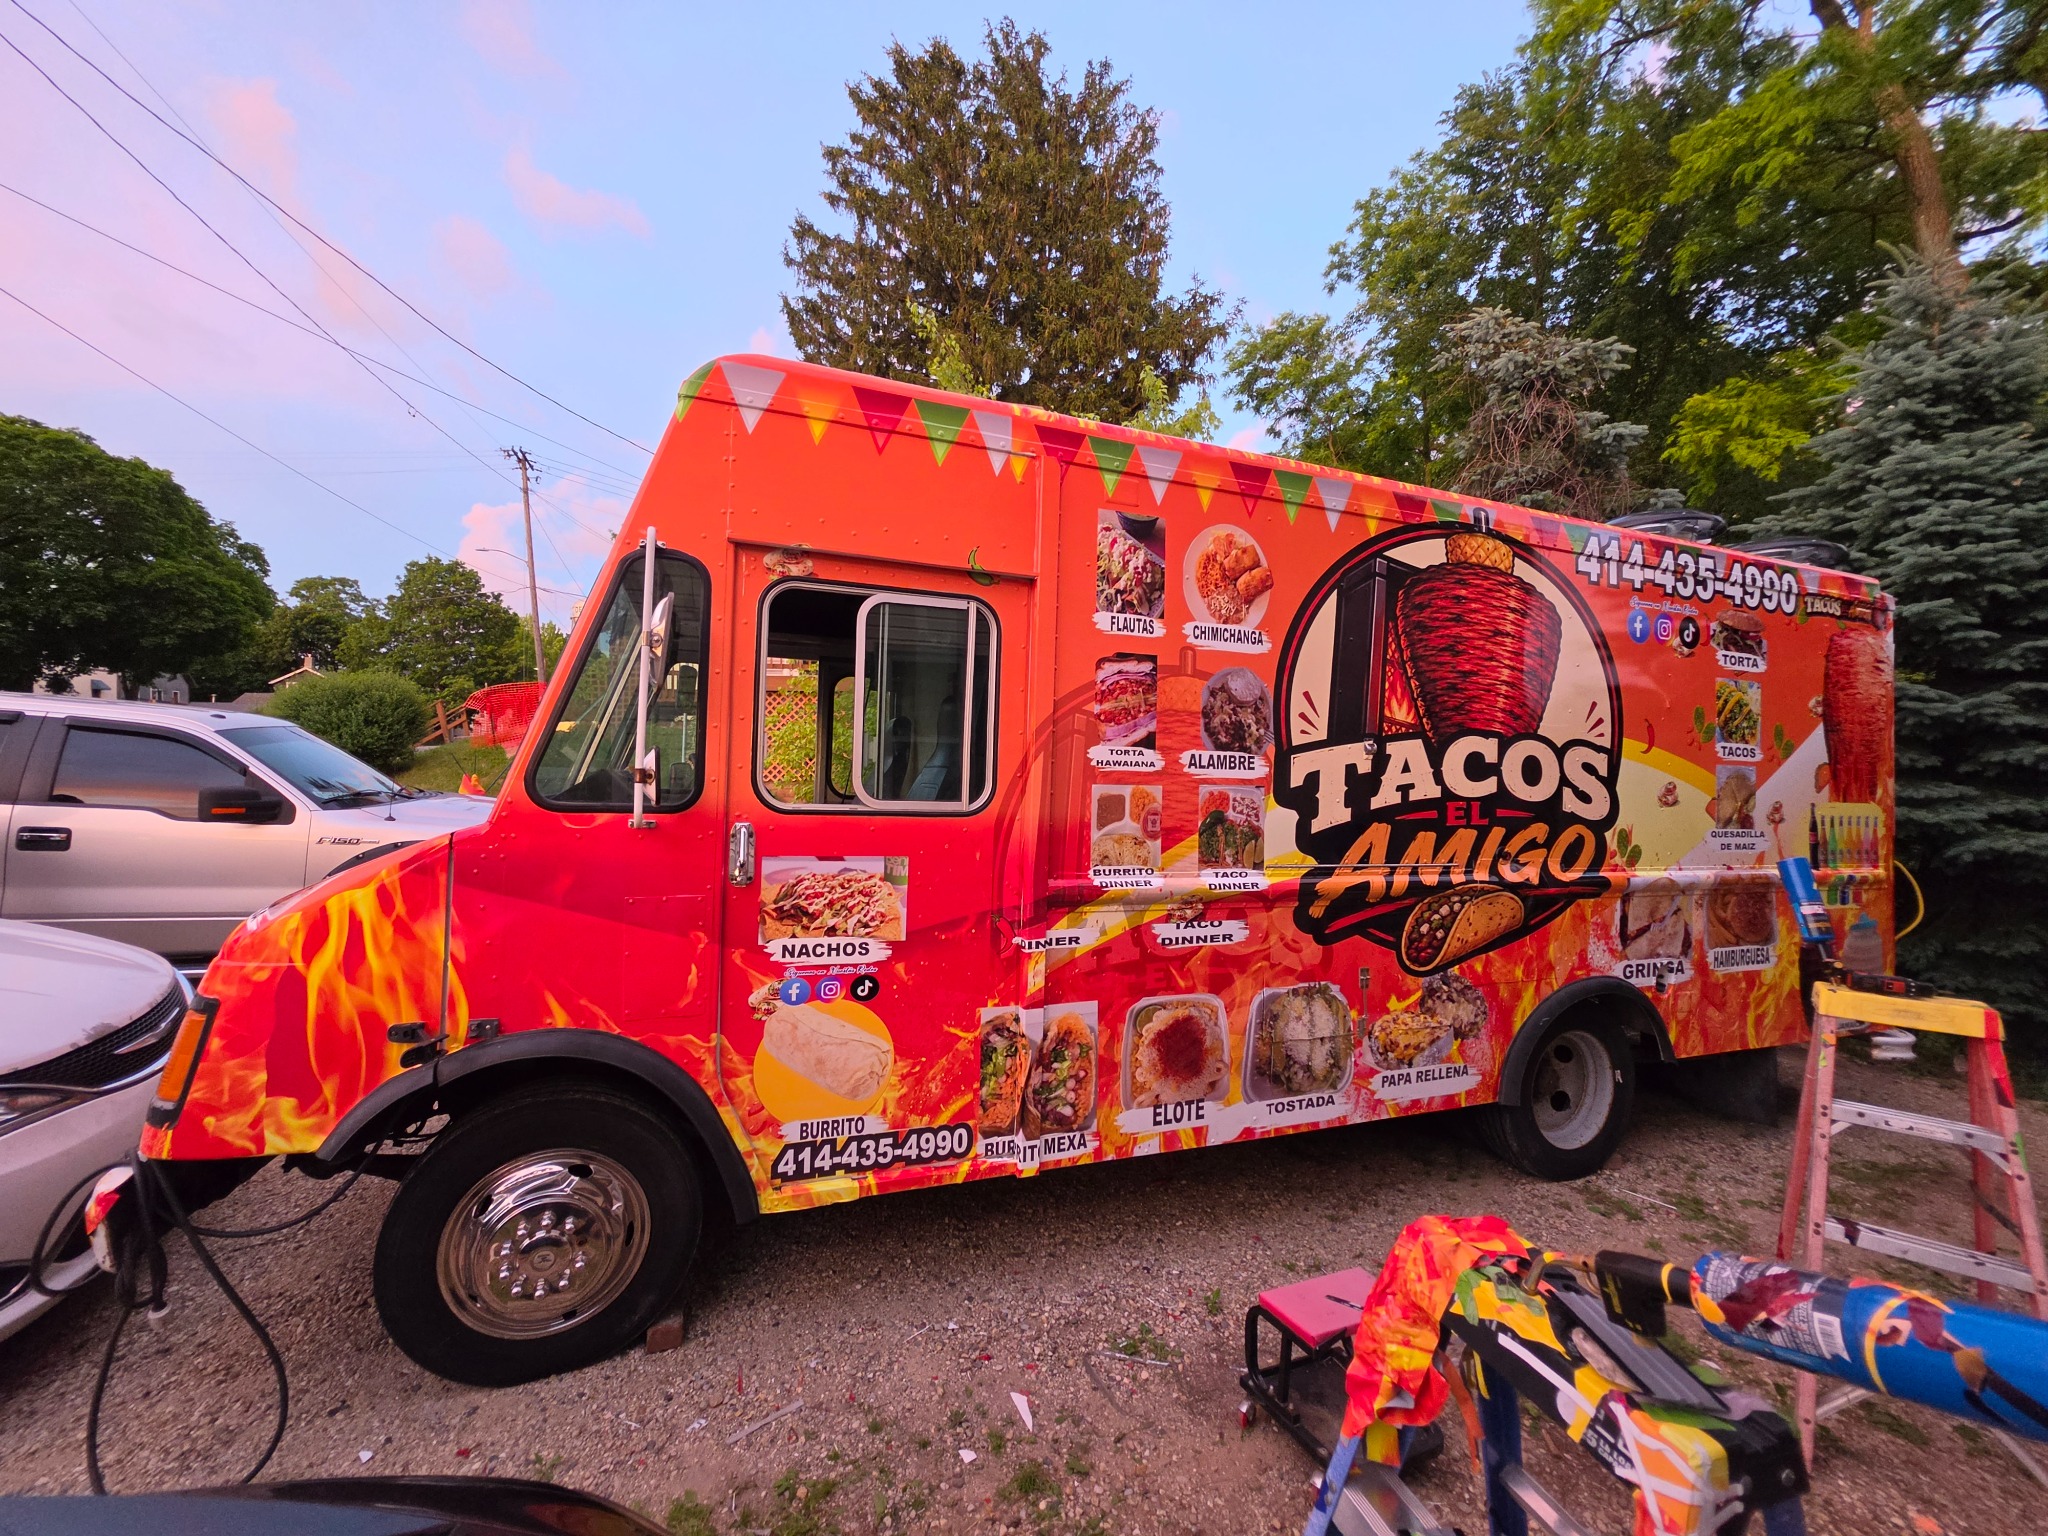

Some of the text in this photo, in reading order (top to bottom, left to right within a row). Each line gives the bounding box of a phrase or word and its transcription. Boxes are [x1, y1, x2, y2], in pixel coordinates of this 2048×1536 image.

[1577, 535, 1799, 615] 414-435-4990
[1805, 595, 1841, 616] TACOS
[1110, 615, 1155, 635] FLAUTAS
[1192, 625, 1264, 647] CHIMICHANGA
[1720, 655, 1759, 669] TORTA
[1108, 748, 1145, 758] TORTA
[1188, 753, 1256, 771] ALAMBRE
[1720, 745, 1757, 759] TACOS
[1096, 759, 1156, 768] HAWAIANA
[1290, 735, 1611, 835] TACOS
[1445, 801, 1490, 826] EL
[1710, 830, 1765, 839] QUESADILLA
[1720, 842, 1757, 851] DE MAIZ
[1092, 867, 1155, 877] BURRITO
[1212, 870, 1248, 879] TACO
[1308, 822, 1597, 919] AMIGO
[1099, 879, 1154, 889] DINNER
[1208, 881, 1260, 891] DINNER
[1175, 920, 1223, 930] TACO
[1161, 933, 1234, 946] DINNER
[781, 941, 870, 959] NACHOS
[1712, 947, 1771, 969] HAMBURGUESA
[1622, 959, 1685, 980] GRINGA
[1381, 1064, 1469, 1089] PAPA RELLENA
[1152, 1098, 1206, 1127] ELOTE
[1266, 1095, 1336, 1115] TOSTADA
[800, 1117, 865, 1140] BURRITO
[777, 1127, 969, 1177] 414-435-4990
[1043, 1132, 1088, 1156] MEXA
